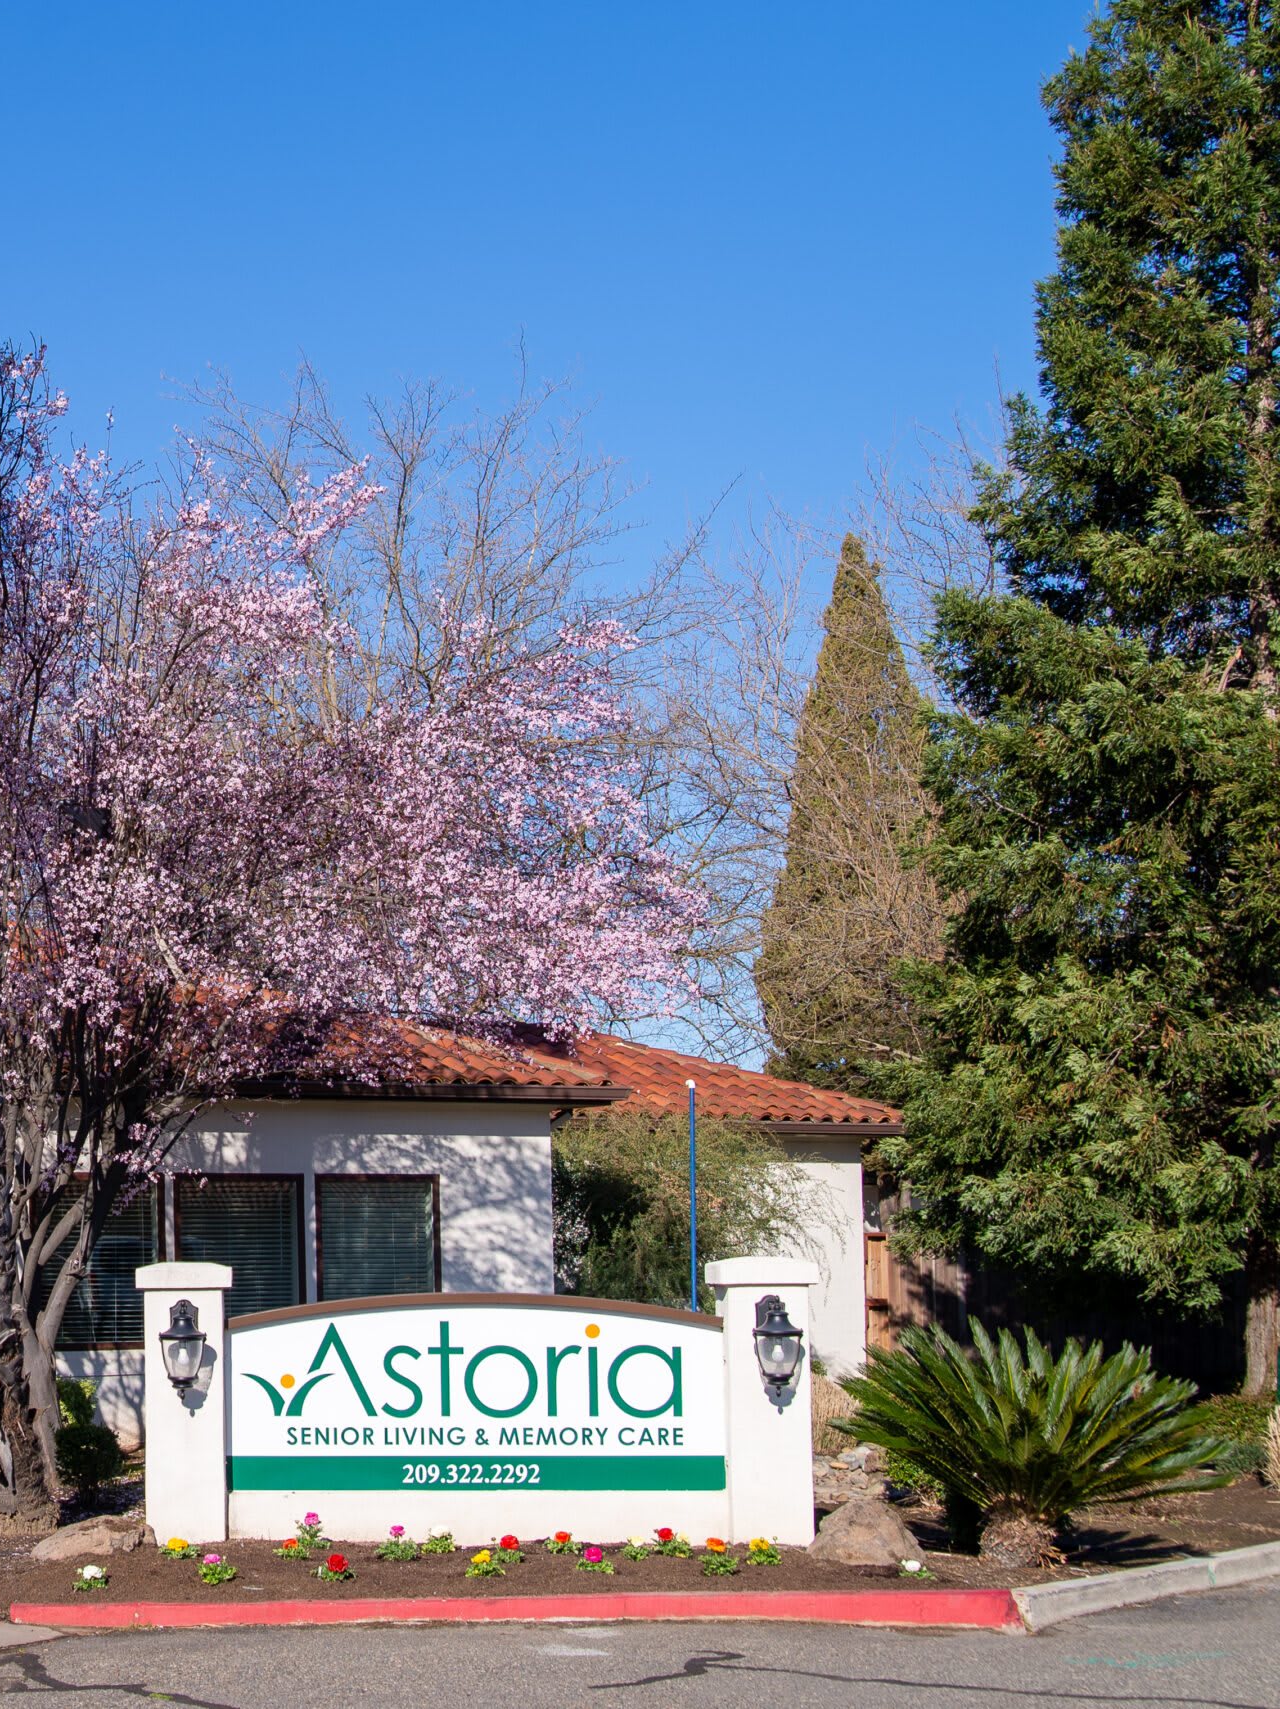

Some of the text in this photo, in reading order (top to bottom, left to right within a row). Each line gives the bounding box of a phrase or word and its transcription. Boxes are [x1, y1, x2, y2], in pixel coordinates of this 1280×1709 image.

[303, 1320, 683, 1418] Astoria
[287, 1427, 684, 1446] SENIOR LIVING & MEMORY CARE
[402, 1464, 541, 1484] 209.322.2292
